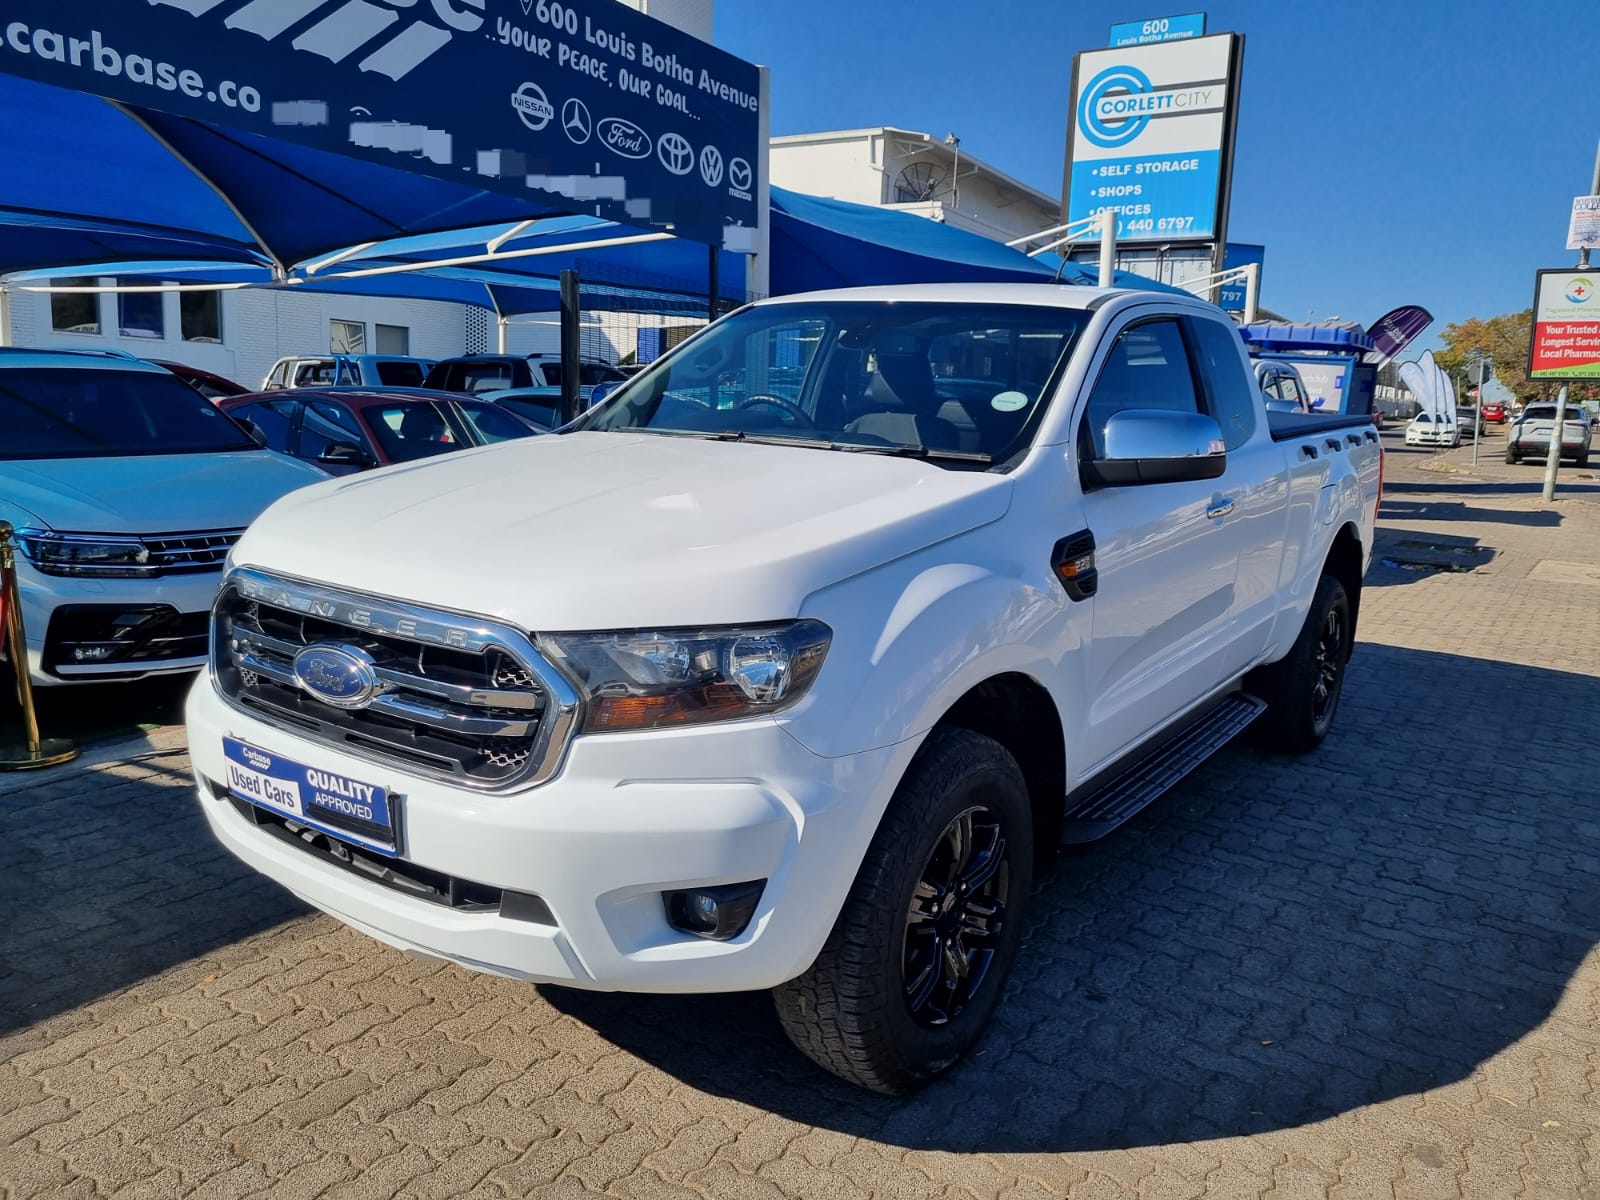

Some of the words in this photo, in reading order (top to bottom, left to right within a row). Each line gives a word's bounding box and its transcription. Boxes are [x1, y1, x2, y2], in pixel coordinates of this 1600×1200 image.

[1142, 19, 1169, 35] 600
[1117, 36, 1138, 46] Louis
[1139, 33, 1162, 44] Botha
[1163, 30, 1194, 40] Avenue
[535, 0, 578, 35] 600
[585, 16, 636, 61] Louis
[642, 42, 694, 86] Botha
[698, 69, 758, 112] Avenue
[619, 68, 651, 98] OUR
[513, 96, 553, 117] NISSAN
[607, 122, 643, 152] Ford
[1099, 164, 1131, 176] SELF
[1135, 159, 1199, 174] STORAGE
[1098, 184, 1142, 197] SHOPS
[1127, 218, 1154, 231] 440
[1157, 216, 1195, 230] 6797
[1546, 324, 1565, 334] Your
[1566, 324, 1598, 334] Trusted
[1541, 337, 1574, 348] Longest
[1540, 349, 1563, 358] Local
[242, 580, 468, 648] RANGER
[306, 657, 347, 692] Ford
[242, 746, 272, 766] Carbase
[230, 765, 262, 795] Used
[263, 778, 295, 808] Cars
[306, 769, 375, 804] QUALITY
[315, 791, 373, 820] APPROVED
